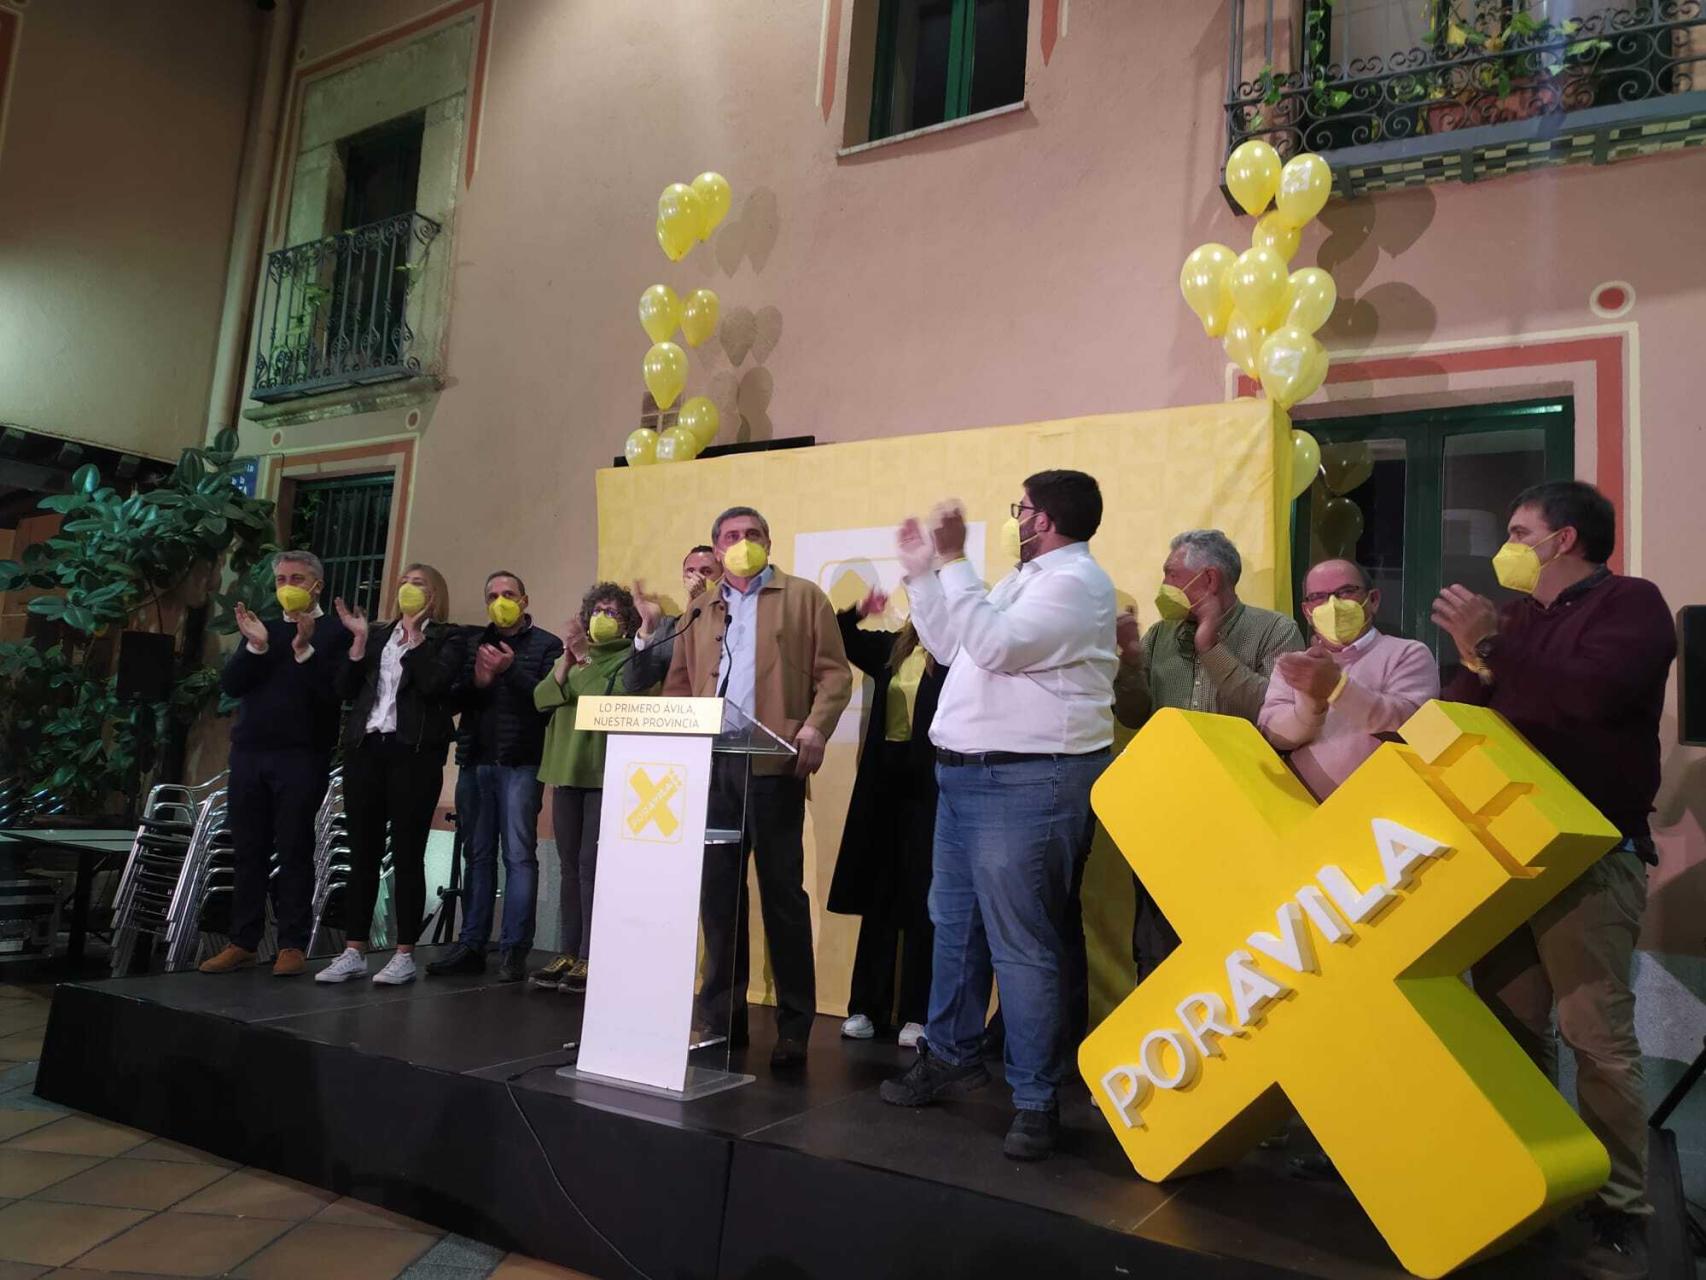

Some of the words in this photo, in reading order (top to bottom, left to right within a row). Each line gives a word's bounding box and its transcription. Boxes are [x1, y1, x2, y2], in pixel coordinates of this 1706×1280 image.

[599, 703, 612, 713] LO
[614, 703, 661, 714] PRIMERO
[593, 717, 640, 727] NUESTRA
[642, 717, 700, 729] PROVINCIA
